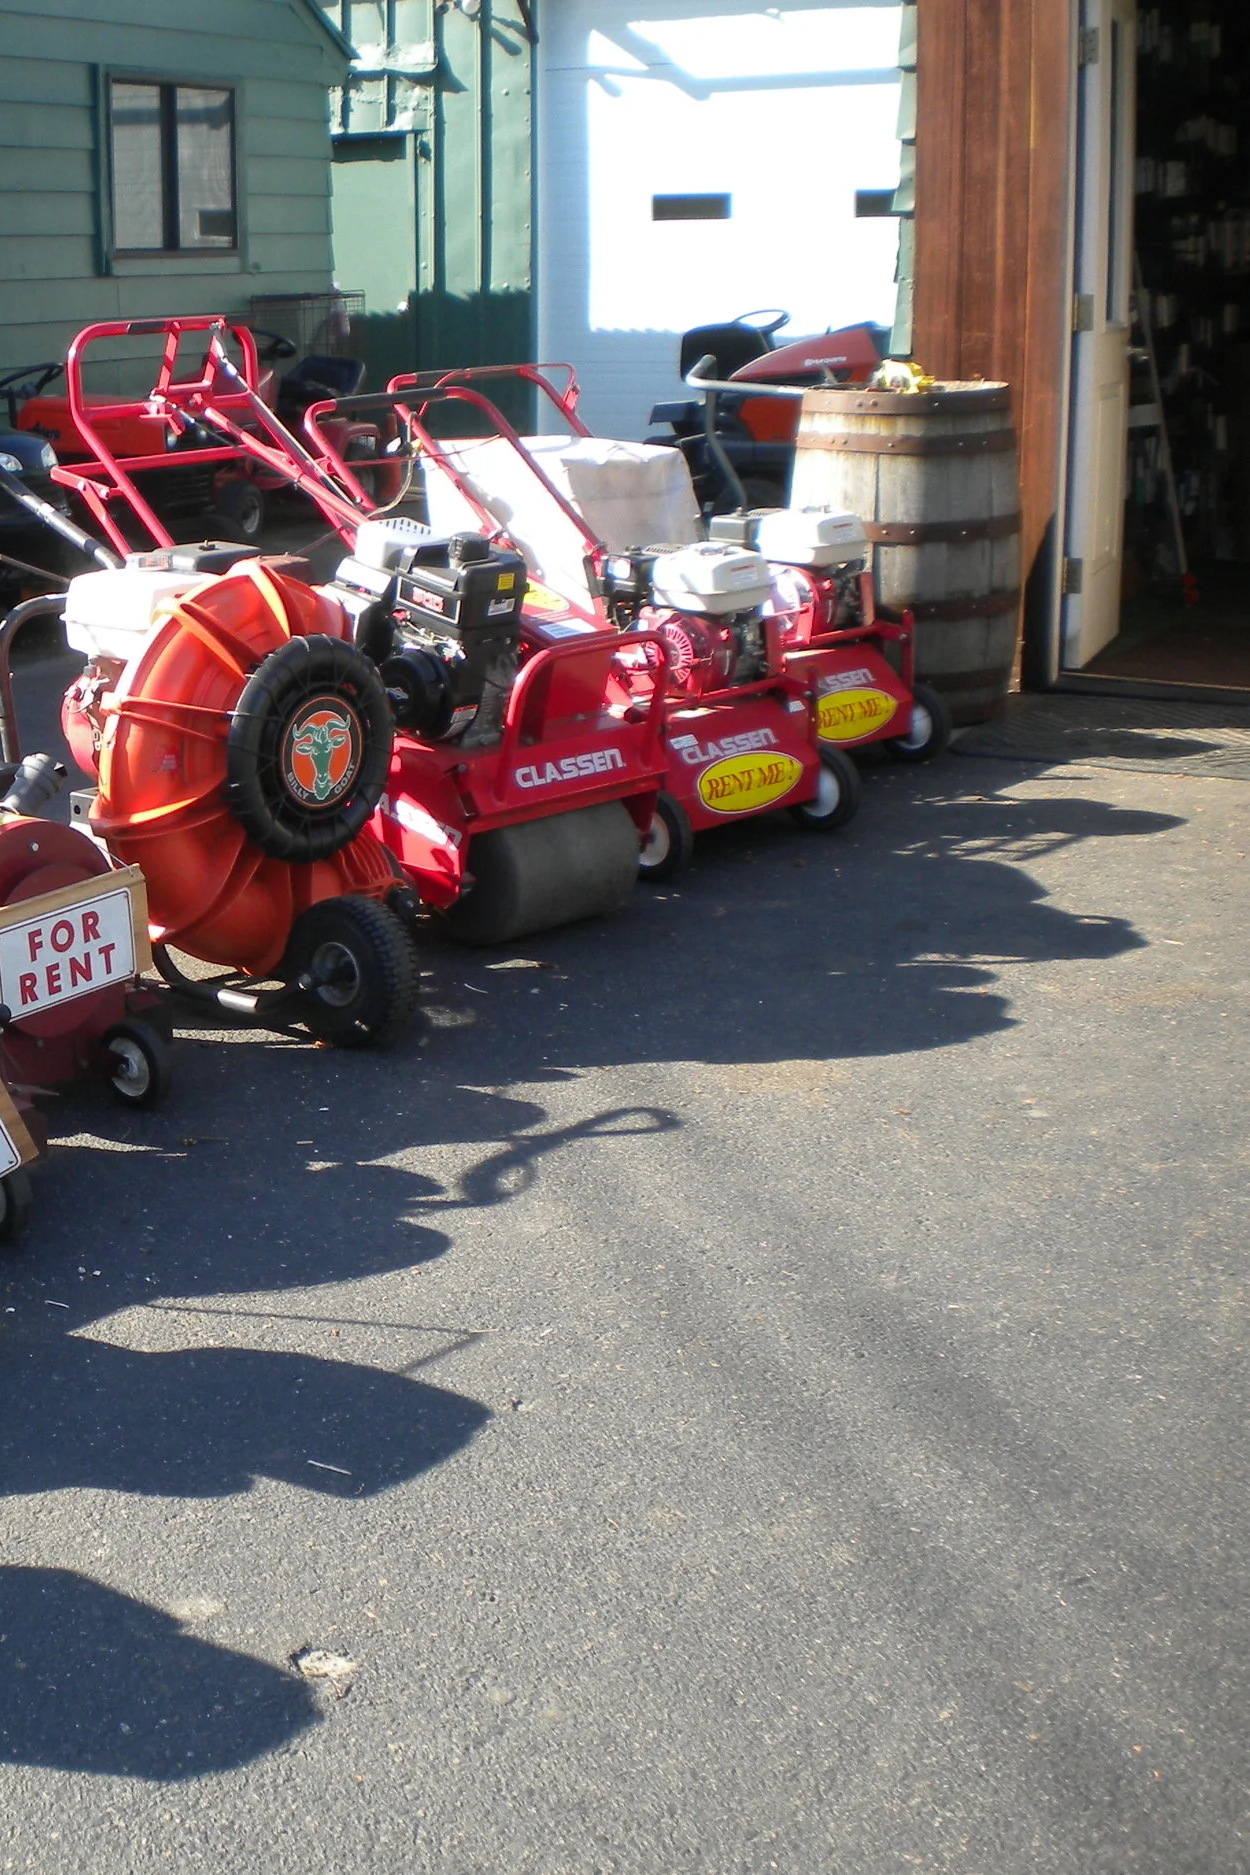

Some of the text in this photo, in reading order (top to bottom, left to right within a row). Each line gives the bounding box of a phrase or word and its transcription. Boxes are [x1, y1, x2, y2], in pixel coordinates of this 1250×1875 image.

[818, 668, 875, 691] ASSEN
[682, 728, 777, 764] CLASSEN
[287, 760, 355, 799] BILLY GOAT
[515, 748, 624, 788] CLASSEN
[707, 769, 755, 801] RENT
[757, 761, 785, 788] ME
[28, 910, 101, 963] FOR
[19, 942, 116, 1006] RENT
